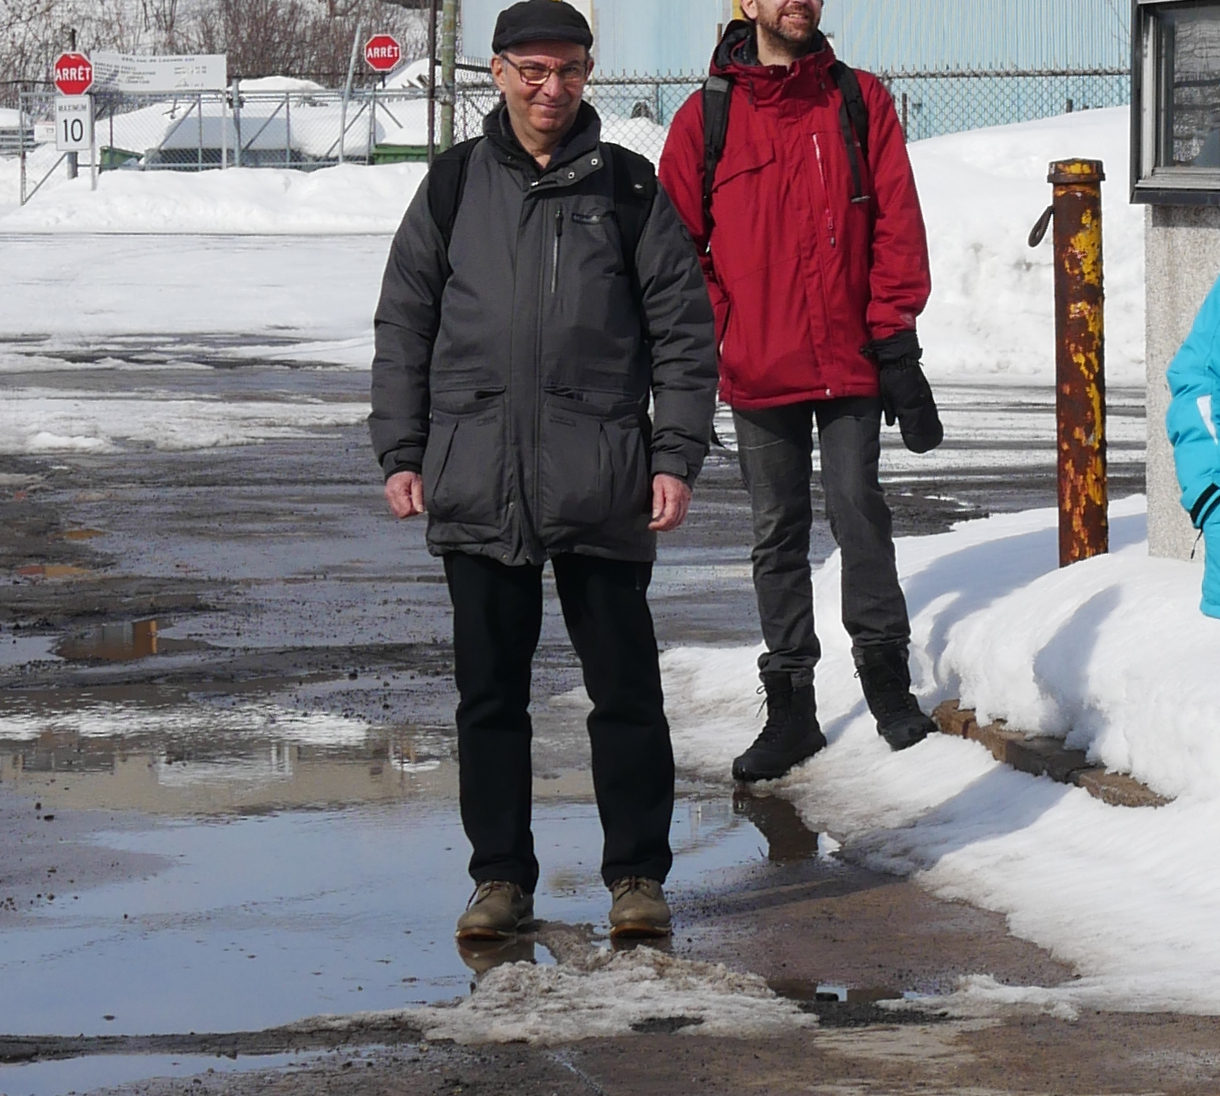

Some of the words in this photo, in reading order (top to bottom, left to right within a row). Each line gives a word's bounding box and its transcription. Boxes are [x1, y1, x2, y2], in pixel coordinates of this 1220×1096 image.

[366, 45, 400, 60] ARRÊT
[56, 65, 92, 81] ARRÊT
[63, 118, 84, 142] 10
